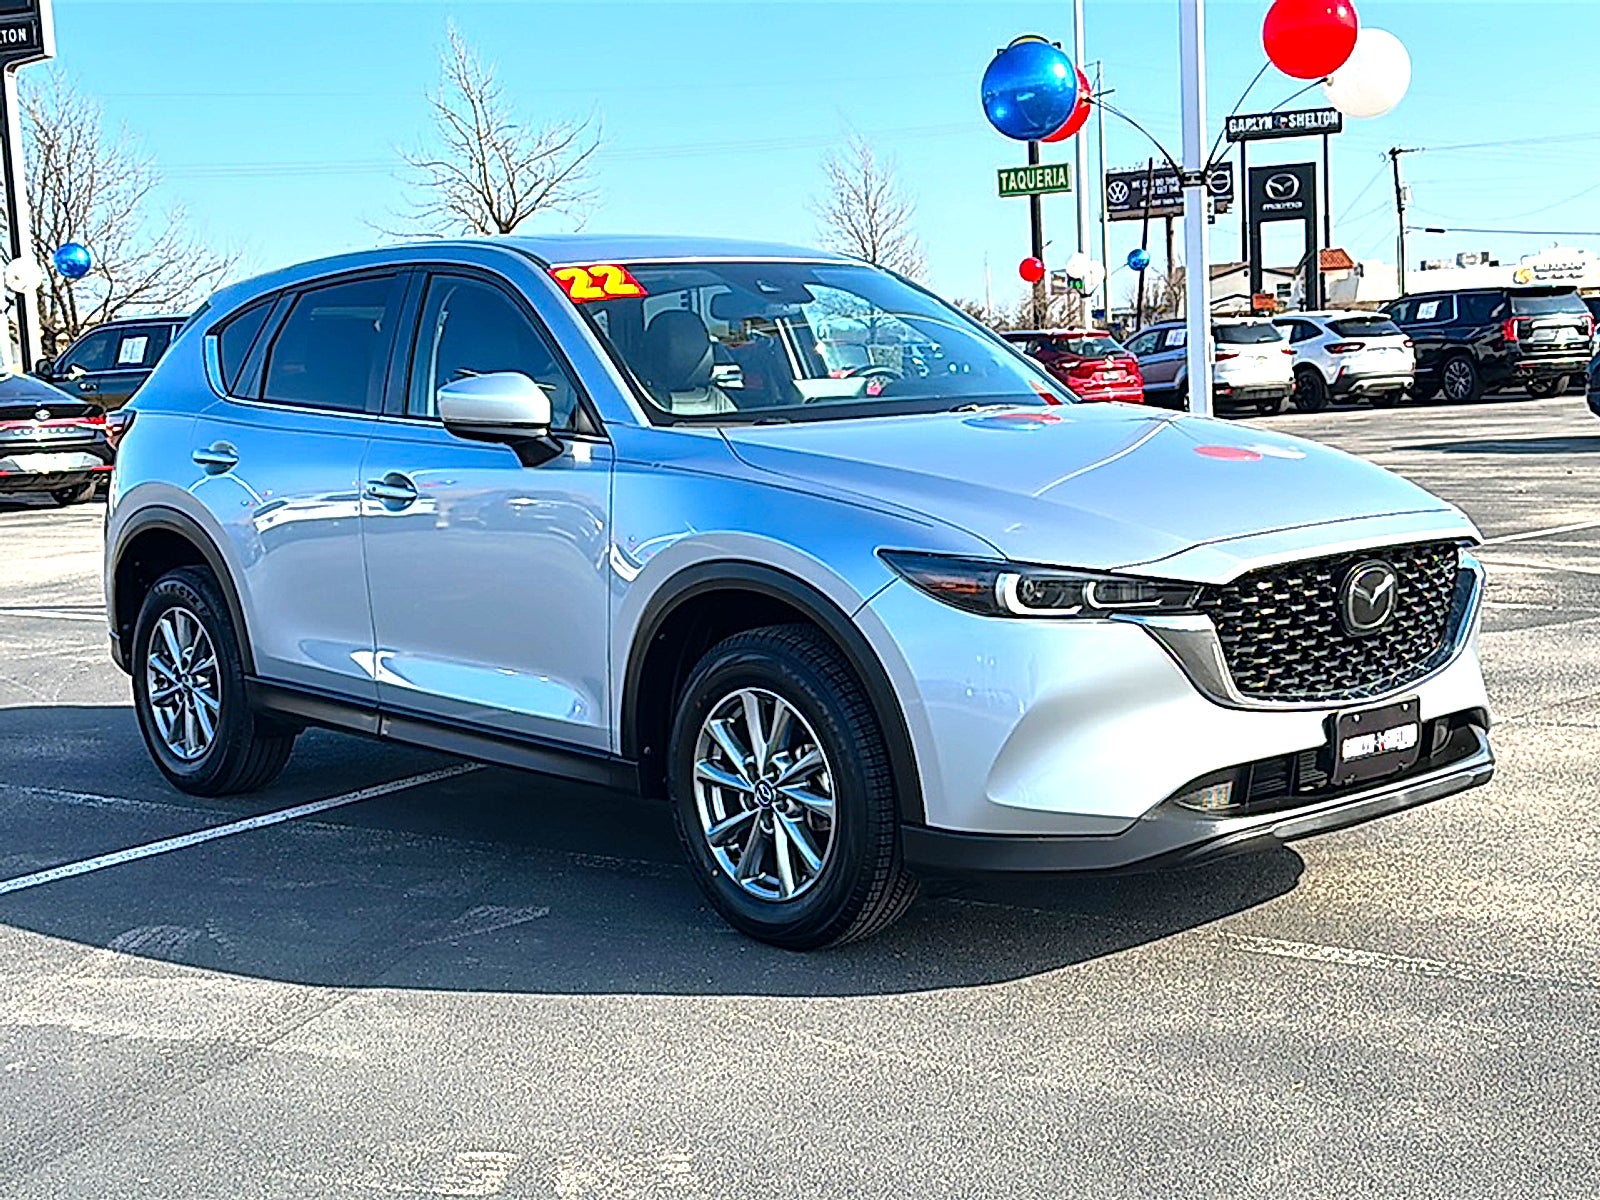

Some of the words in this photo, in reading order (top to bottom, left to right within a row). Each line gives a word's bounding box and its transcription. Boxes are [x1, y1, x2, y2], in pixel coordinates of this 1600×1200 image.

[1288, 111, 1339, 129] SHELTON
[1000, 167, 1066, 191] TAQUERIA
[555, 265, 640, 299] 22
